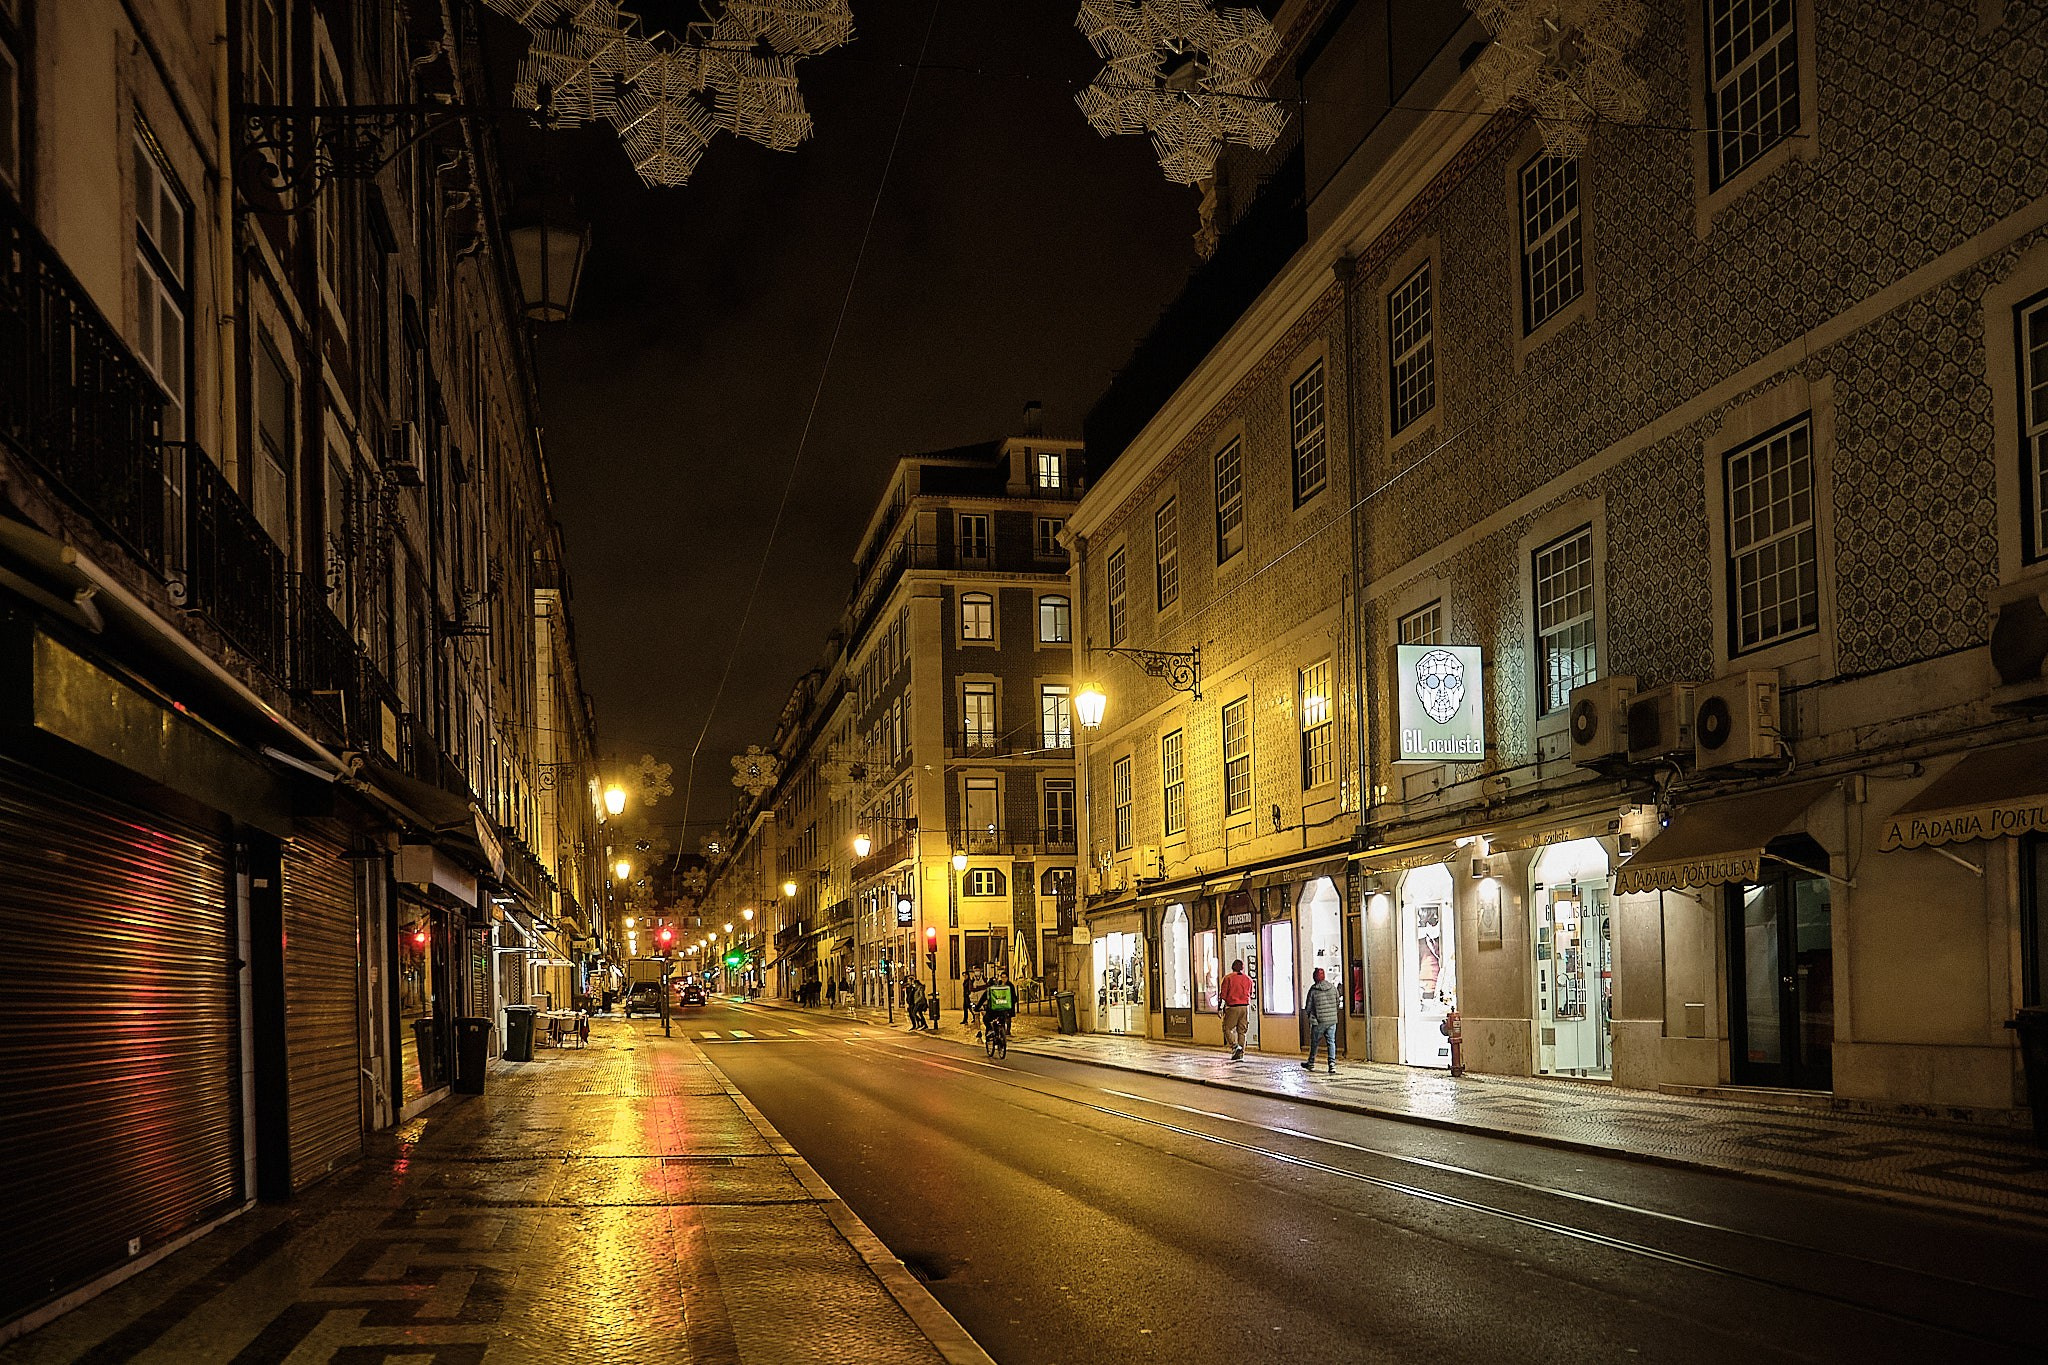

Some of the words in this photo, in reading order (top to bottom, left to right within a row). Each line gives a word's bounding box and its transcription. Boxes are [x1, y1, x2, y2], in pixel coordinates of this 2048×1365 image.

[1402, 729, 1427, 753] GIL
[1429, 735, 1481, 754] oculista
[1888, 823, 1902, 842] A
[1911, 816, 1983, 840] PADARIA
[1619, 873, 1629, 888] A
[1634, 870, 1677, 887] PADARIA
[1682, 860, 1756, 882] PORTUGUESA
[1228, 912, 1251, 925] OPTOCENTRO
